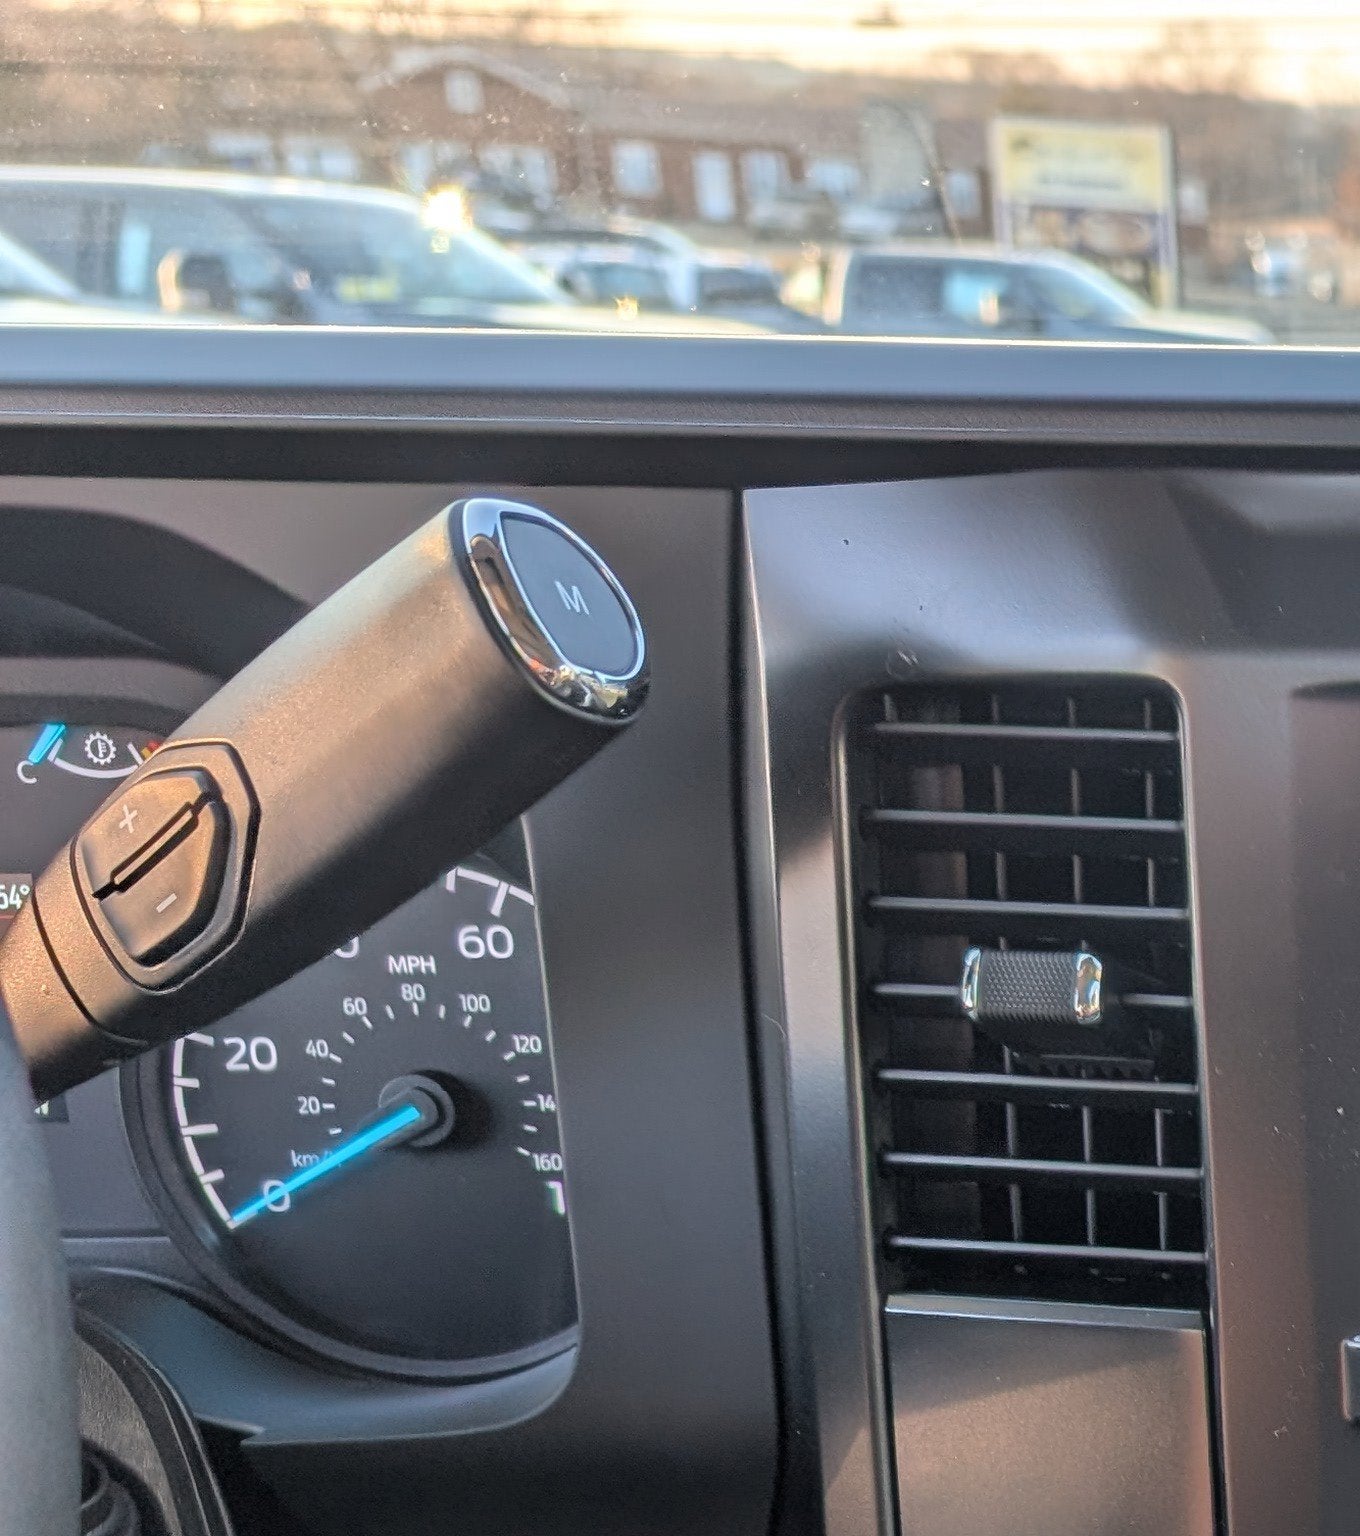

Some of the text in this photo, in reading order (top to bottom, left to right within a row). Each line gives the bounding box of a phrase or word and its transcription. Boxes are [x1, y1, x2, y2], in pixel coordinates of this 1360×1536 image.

[554, 580, 590, 616] M
[457, 924, 515, 960] 60
[388, 953, 437, 976] MPH
[400, 983, 427, 1002] 80
[342, 996, 369, 1016] 60
[458, 993, 492, 1014] 100
[222, 1035, 279, 1072] 20
[305, 1038, 330, 1058] 40
[511, 1034, 543, 1054] 120
[297, 1095, 321, 1115] 20
[532, 1152, 563, 1172] 160
